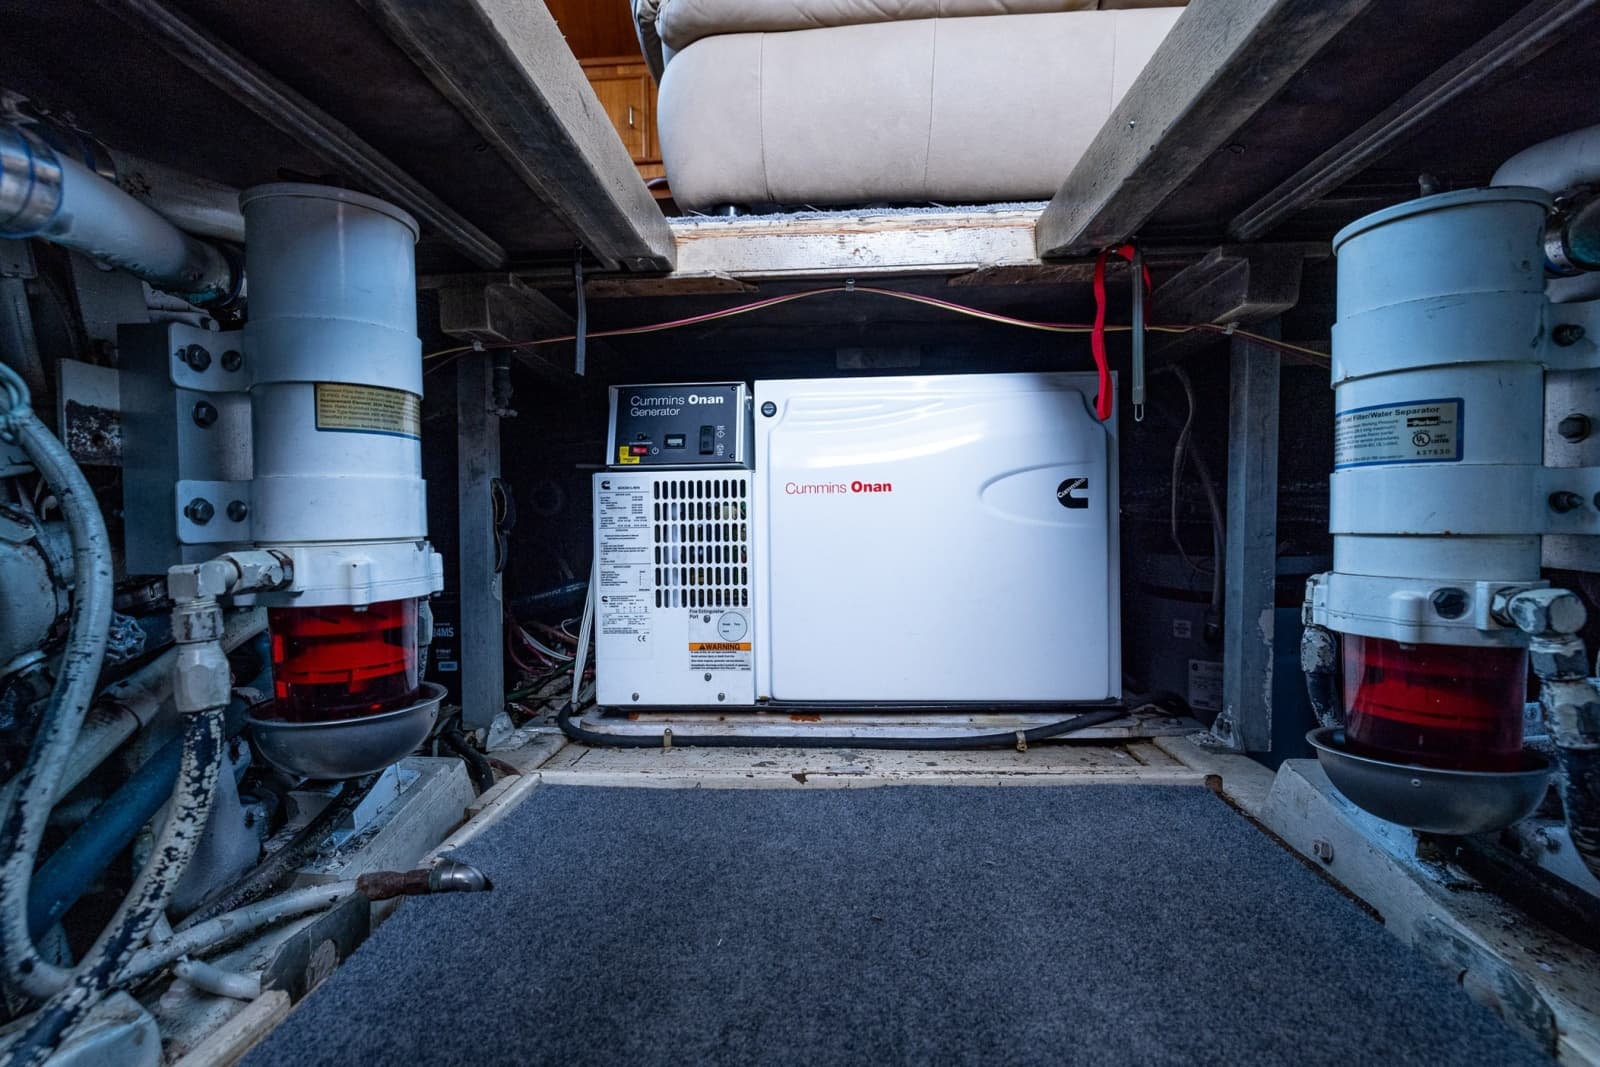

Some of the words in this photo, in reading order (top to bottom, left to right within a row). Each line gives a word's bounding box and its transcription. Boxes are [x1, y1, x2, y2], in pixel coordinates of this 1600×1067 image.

[630, 395, 685, 406] Cummins
[688, 394, 724, 404] Onan
[630, 407, 681, 417] Generator
[1395, 407, 1440, 417] Separator
[785, 481, 847, 495] Cummins
[851, 480, 892, 493] Onan
[1057, 478, 1087, 498] Cummins
